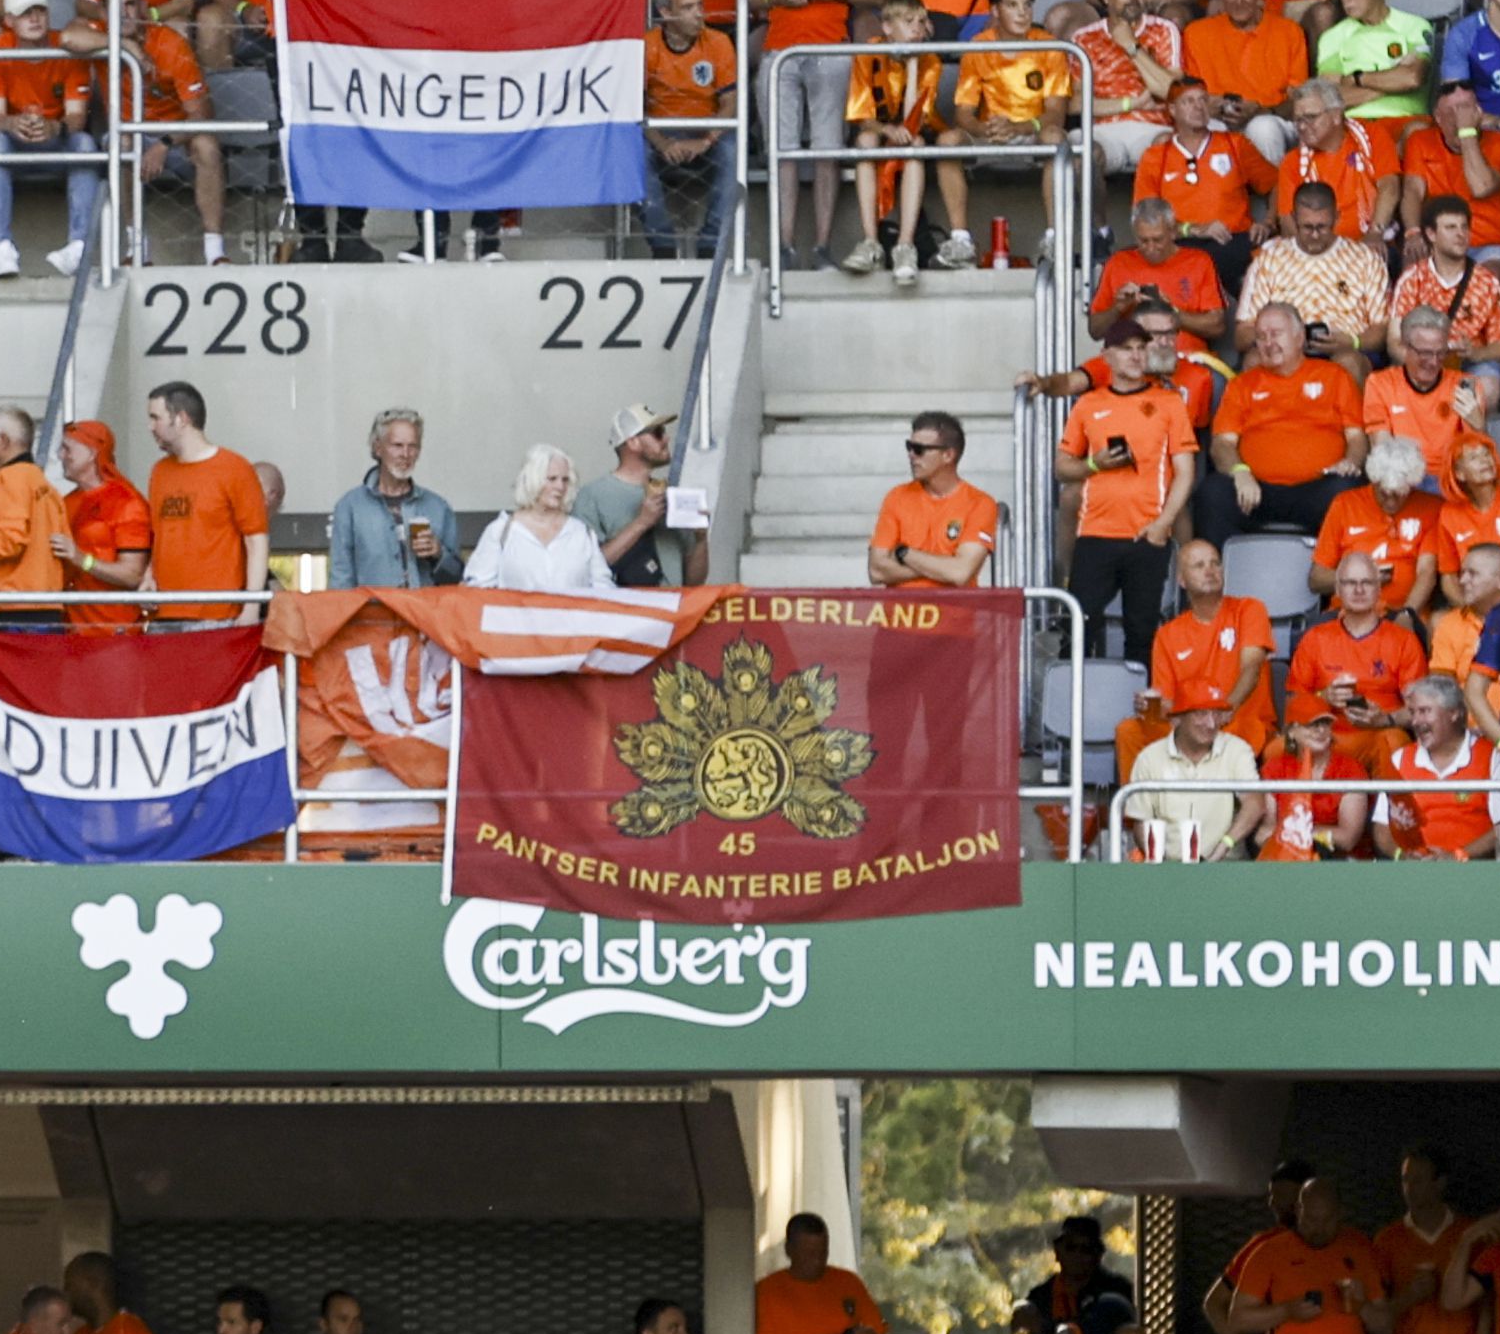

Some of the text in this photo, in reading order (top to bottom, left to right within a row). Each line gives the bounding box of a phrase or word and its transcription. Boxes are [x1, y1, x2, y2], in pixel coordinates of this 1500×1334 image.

[306, 60, 613, 122] LANGEDIJK
[143, 280, 311, 358] 228
[538, 275, 706, 353] 227
[2, 692, 259, 792] DUIVEN
[475, 821, 1001, 900] PANTSER INFANTERIE BATALJON
[718, 832, 756, 857] 45
[443, 895, 812, 1034] Carlsberg
